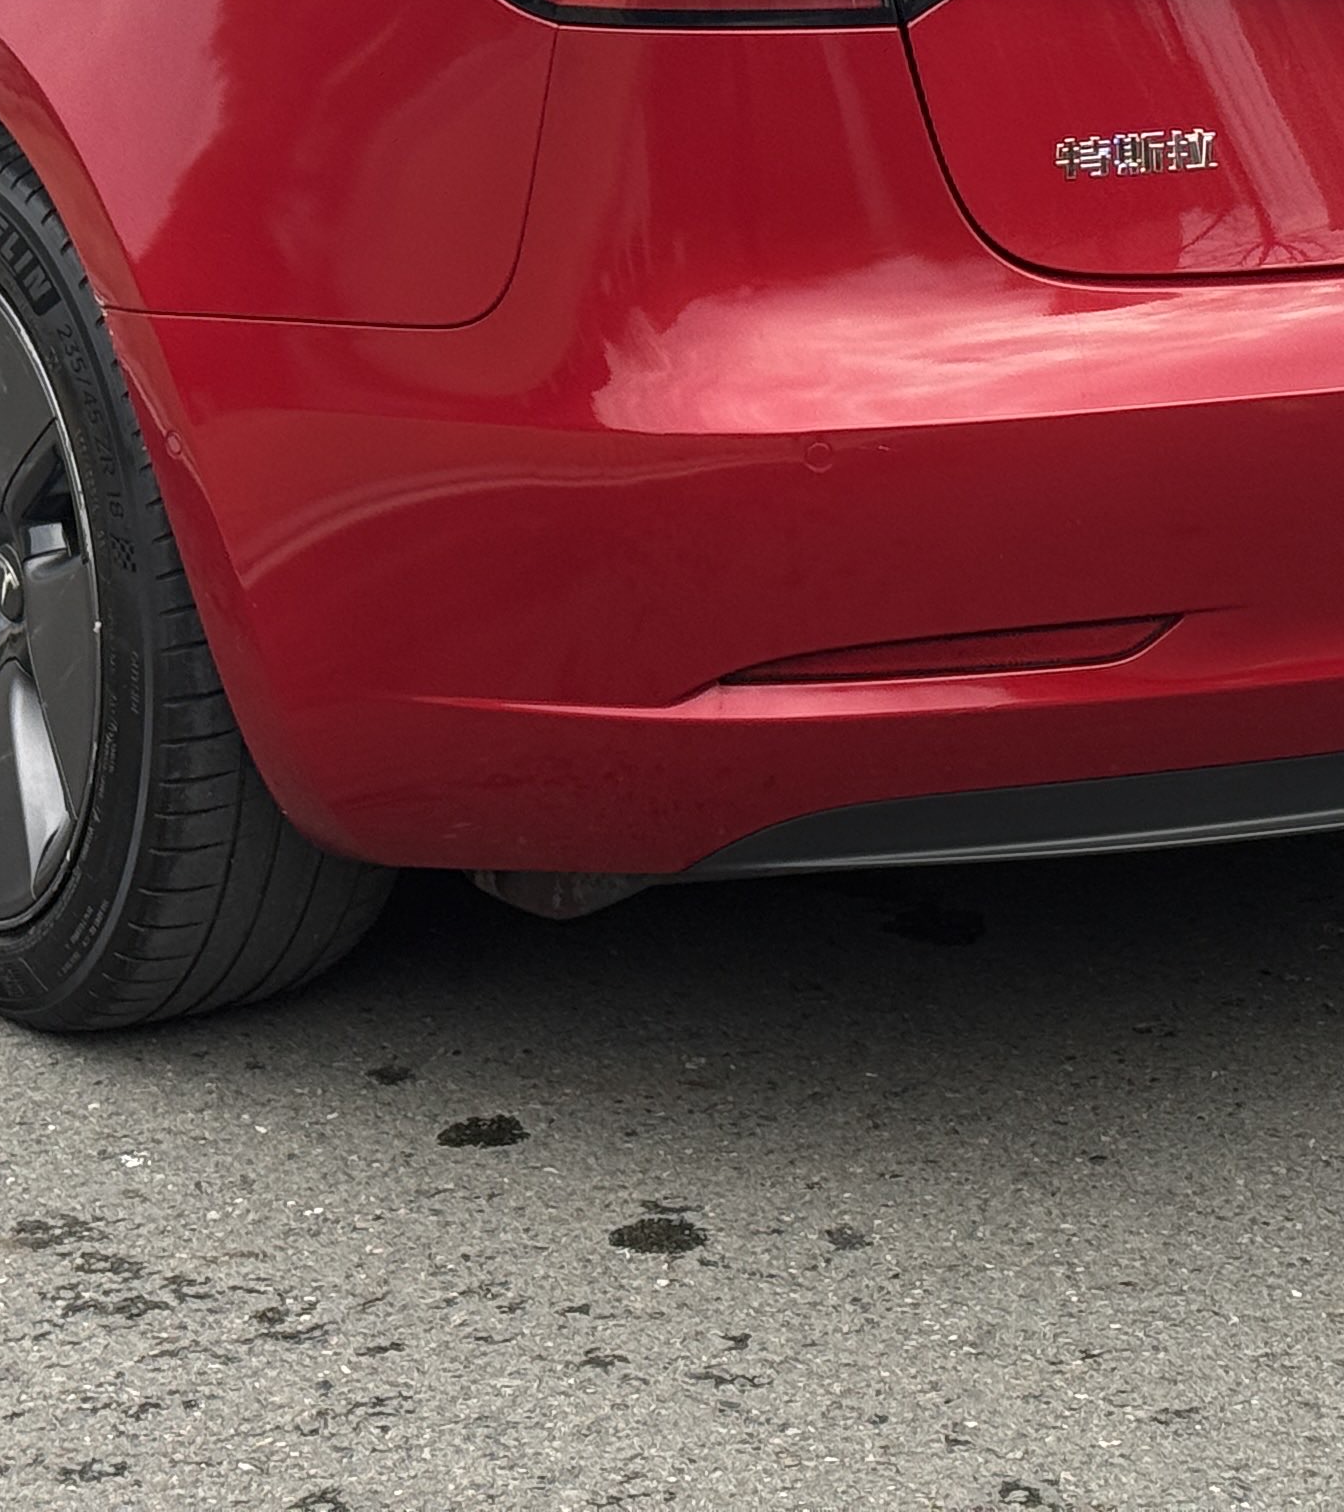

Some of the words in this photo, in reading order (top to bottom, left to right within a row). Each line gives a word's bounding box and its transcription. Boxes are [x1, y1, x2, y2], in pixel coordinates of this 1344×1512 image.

[1055, 128, 1218, 180] 特斯拉
[57, 324, 104, 425] 235/45
[106, 491, 125, 519] 18
